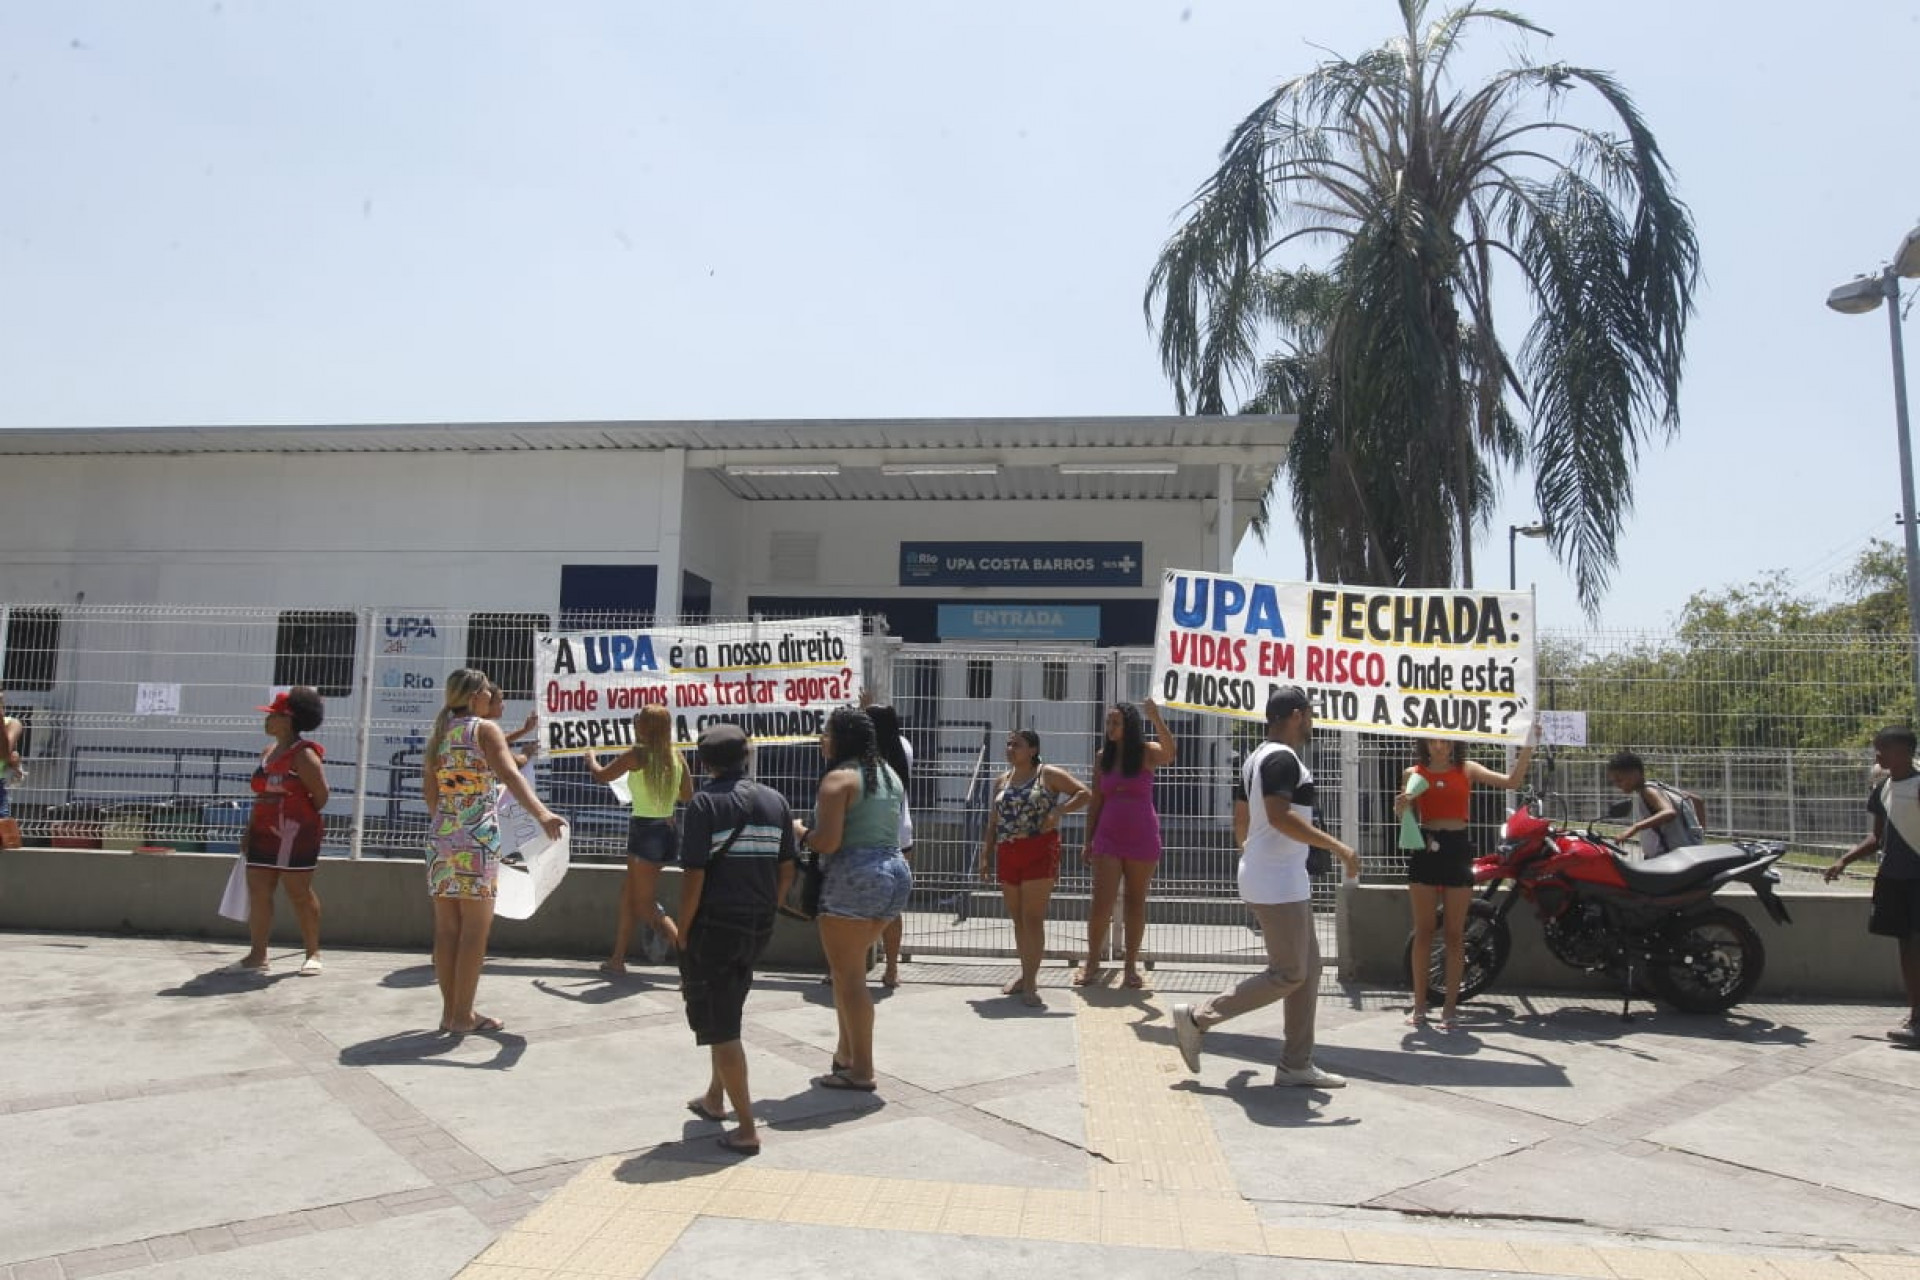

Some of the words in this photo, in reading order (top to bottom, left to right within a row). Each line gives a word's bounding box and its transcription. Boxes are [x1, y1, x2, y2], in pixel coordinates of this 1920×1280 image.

[946, 558, 975, 571] UPA
[979, 558, 1030, 571] COSTA
[1033, 558, 1095, 571] BARROS
[385, 617, 437, 638] UPA
[973, 609, 1063, 626] ENTRADA
[1309, 588, 1520, 646] FECHADA:
[583, 634, 659, 674] UPA
[669, 637, 683, 668] é
[694, 644, 708, 668] o
[717, 640, 772, 667] nosso
[1169, 630, 1248, 673] VIDAS
[1257, 641, 1295, 680] EM
[1306, 645, 1391, 688] RISCO.
[1397, 653, 1453, 691] Onde
[1461, 656, 1519, 693] está
[403, 672, 434, 689] Rio
[547, 680, 599, 713] Onde
[607, 684, 668, 710] vamos
[675, 683, 709, 708] nos
[714, 673, 779, 706] tratar
[785, 667, 853, 707] agora?
[1163, 669, 1179, 701] O
[1185, 671, 1256, 711] NOSSO
[1372, 694, 1392, 726] A
[675, 714, 691, 743] A
